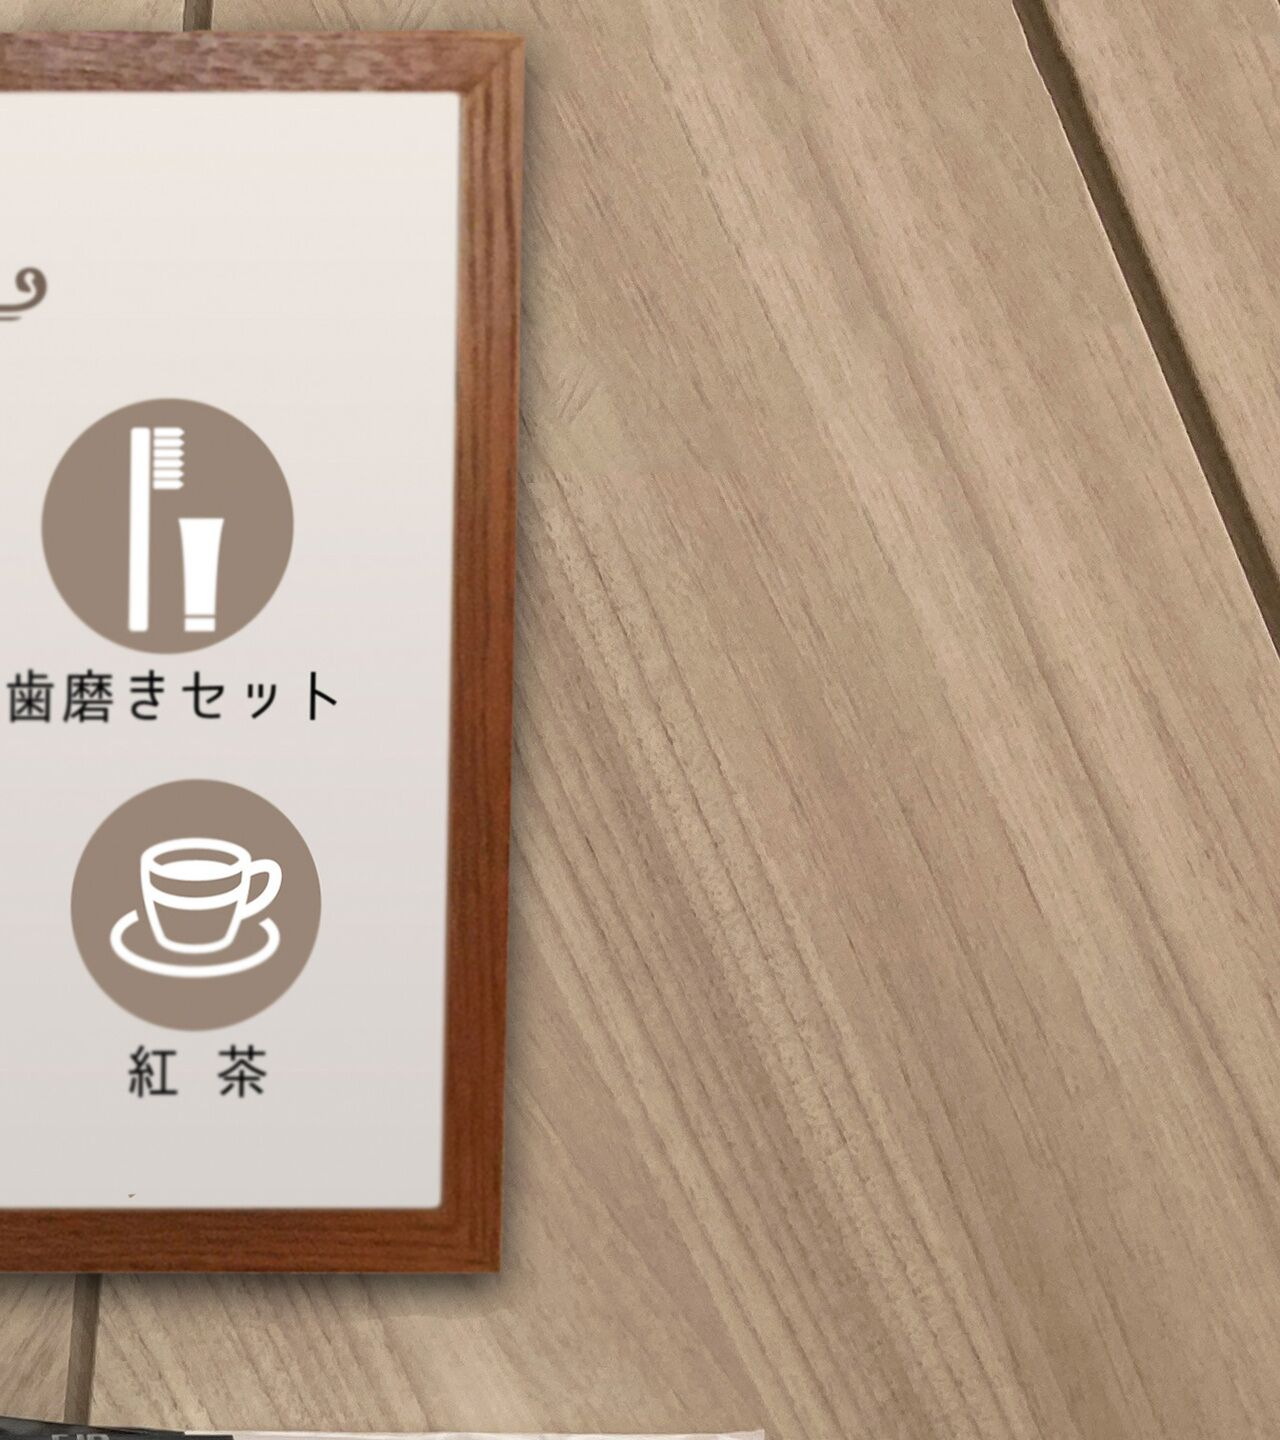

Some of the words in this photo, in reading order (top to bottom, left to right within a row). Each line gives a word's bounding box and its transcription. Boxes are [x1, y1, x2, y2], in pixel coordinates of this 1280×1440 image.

[6, 668, 338, 724] 歯磨きセット
